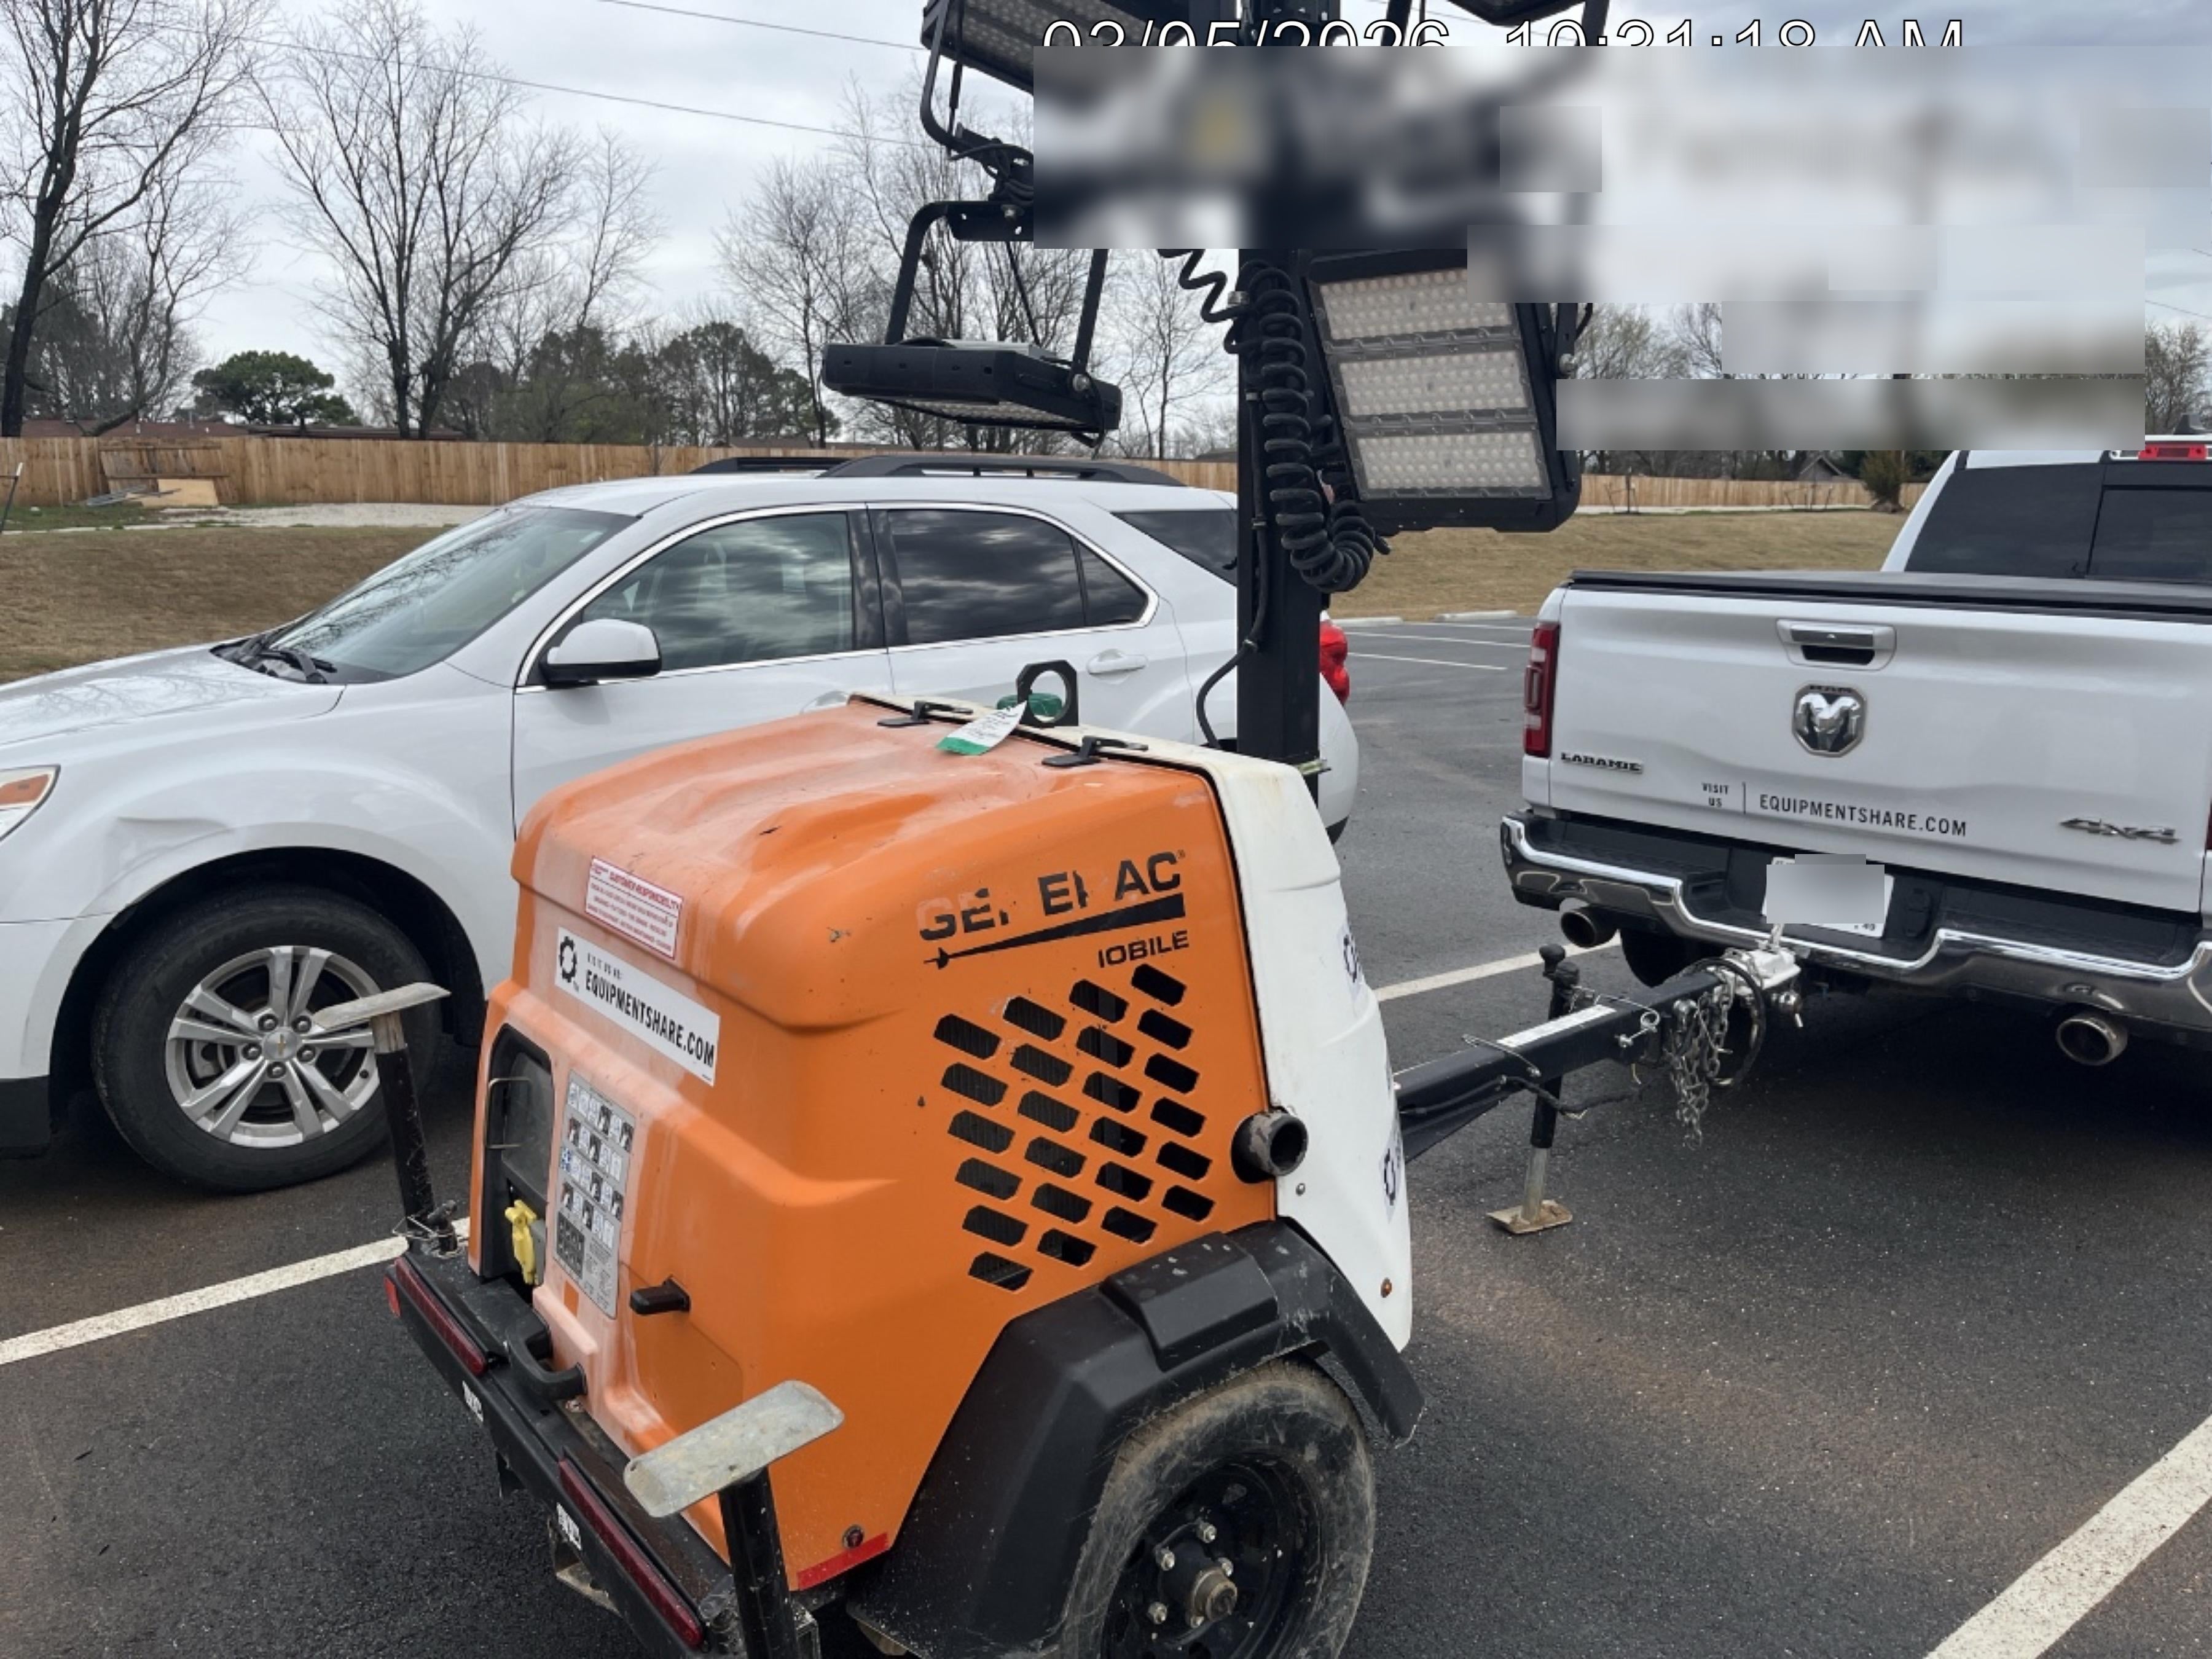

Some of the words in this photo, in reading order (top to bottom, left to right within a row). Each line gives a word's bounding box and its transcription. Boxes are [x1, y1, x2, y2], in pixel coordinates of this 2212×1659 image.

[1701, 782, 1730, 795] VISIT
[1709, 798, 1723, 807] US
[1759, 793, 1967, 837] EQUIPMENTSHARE.COM
[585, 968, 715, 1068] EQUIPMENTSHARE.COM
